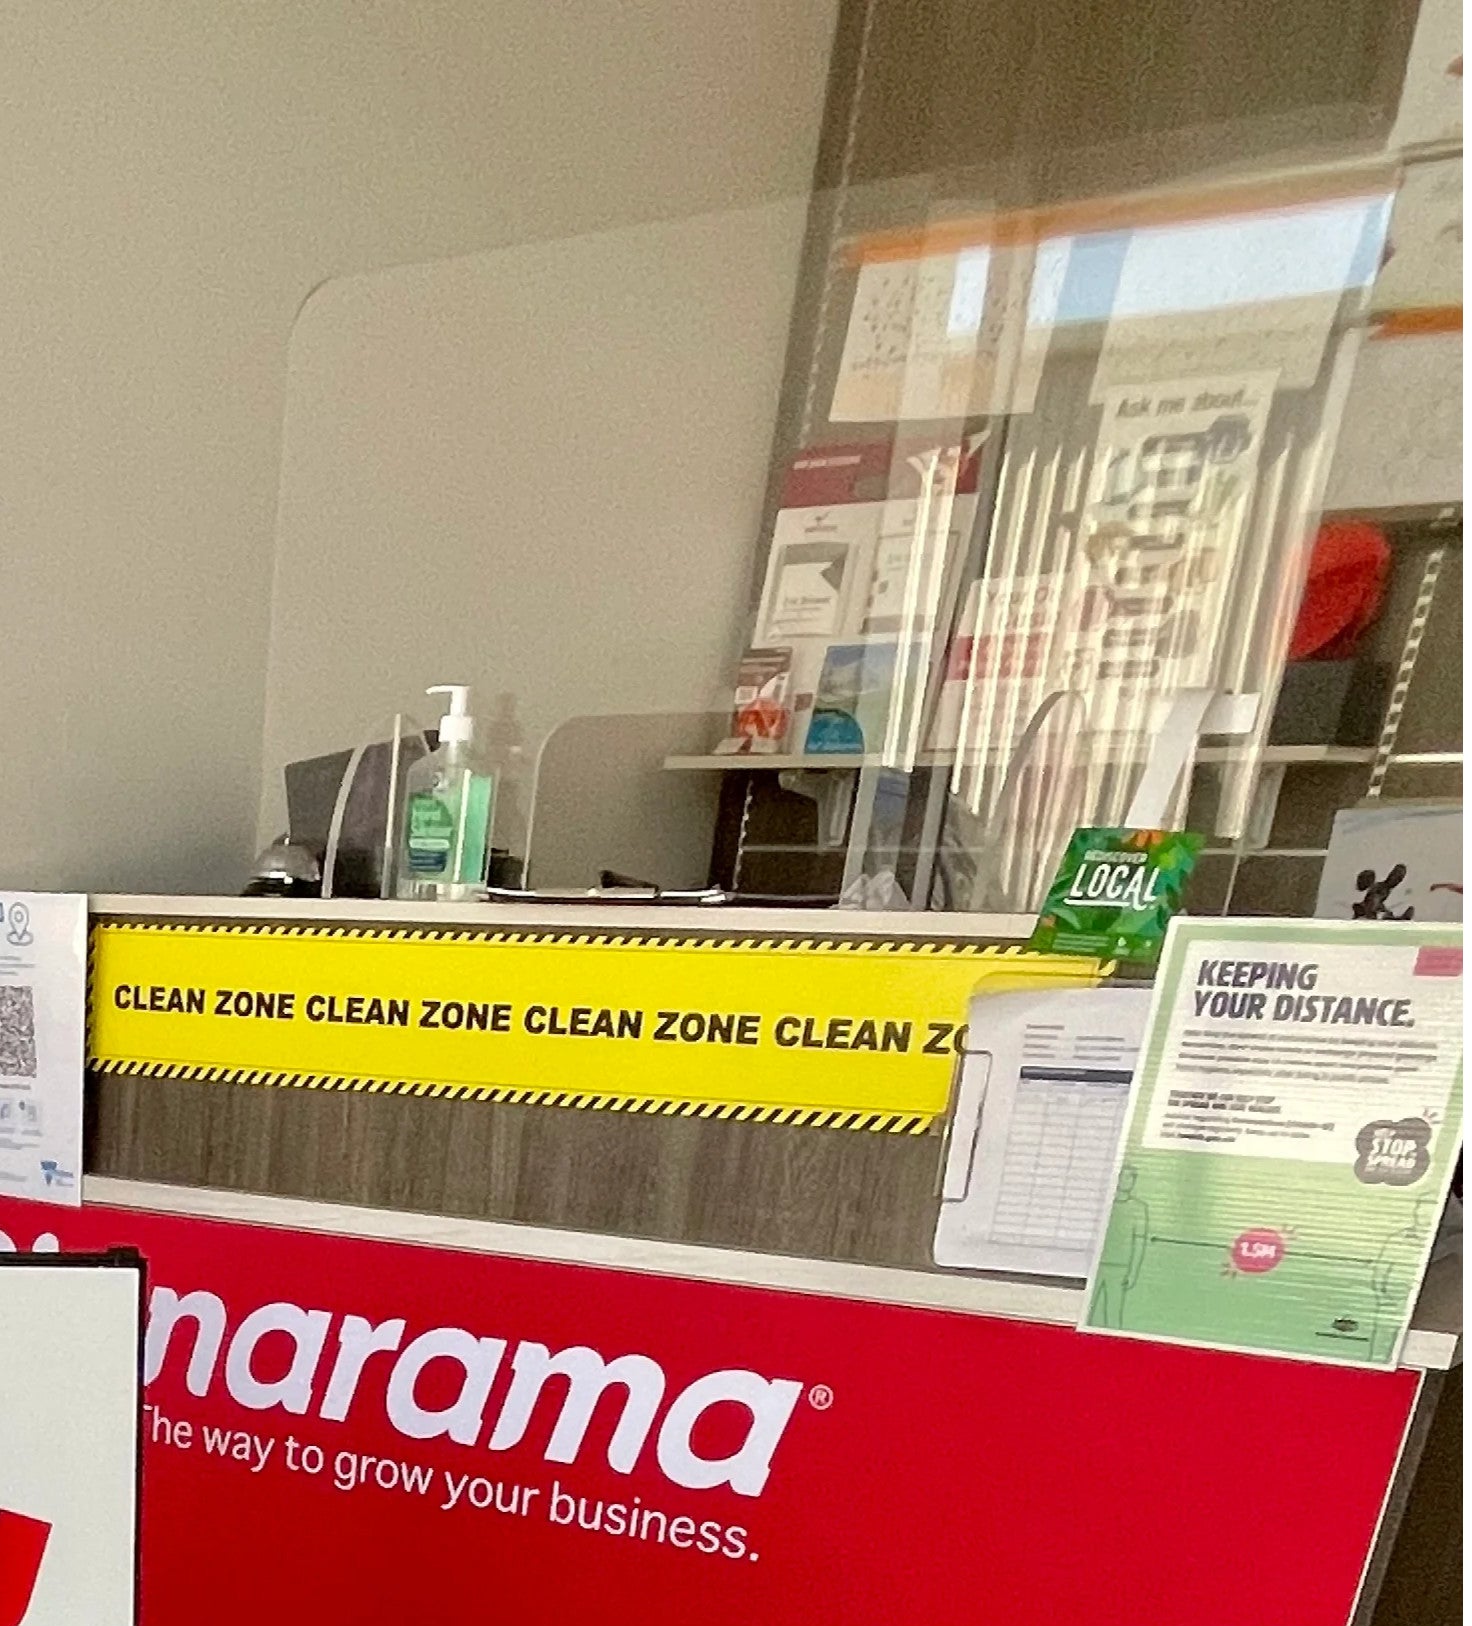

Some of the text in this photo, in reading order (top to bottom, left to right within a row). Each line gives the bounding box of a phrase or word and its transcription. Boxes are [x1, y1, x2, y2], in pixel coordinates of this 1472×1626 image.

[1070, 863, 1160, 911] LOCAL
[1196, 960, 1318, 990] KEEPING
[114, 985, 206, 1015] CLEAN
[214, 990, 295, 1020] ZONE
[306, 995, 409, 1027] CLEAN
[419, 1001, 512, 1033] ZONE
[523, 1006, 643, 1040] CLEAN
[653, 1011, 761, 1046] ZONE
[774, 1016, 913, 1053] CLEAN
[1194, 991, 1416, 1028] YOUR DISTANCE.
[202, 1425, 276, 1473] way
[285, 1435, 324, 1475] to
[334, 1450, 433, 1496] grow
[440, 1470, 540, 1518] your
[549, 1480, 761, 1562] business.
